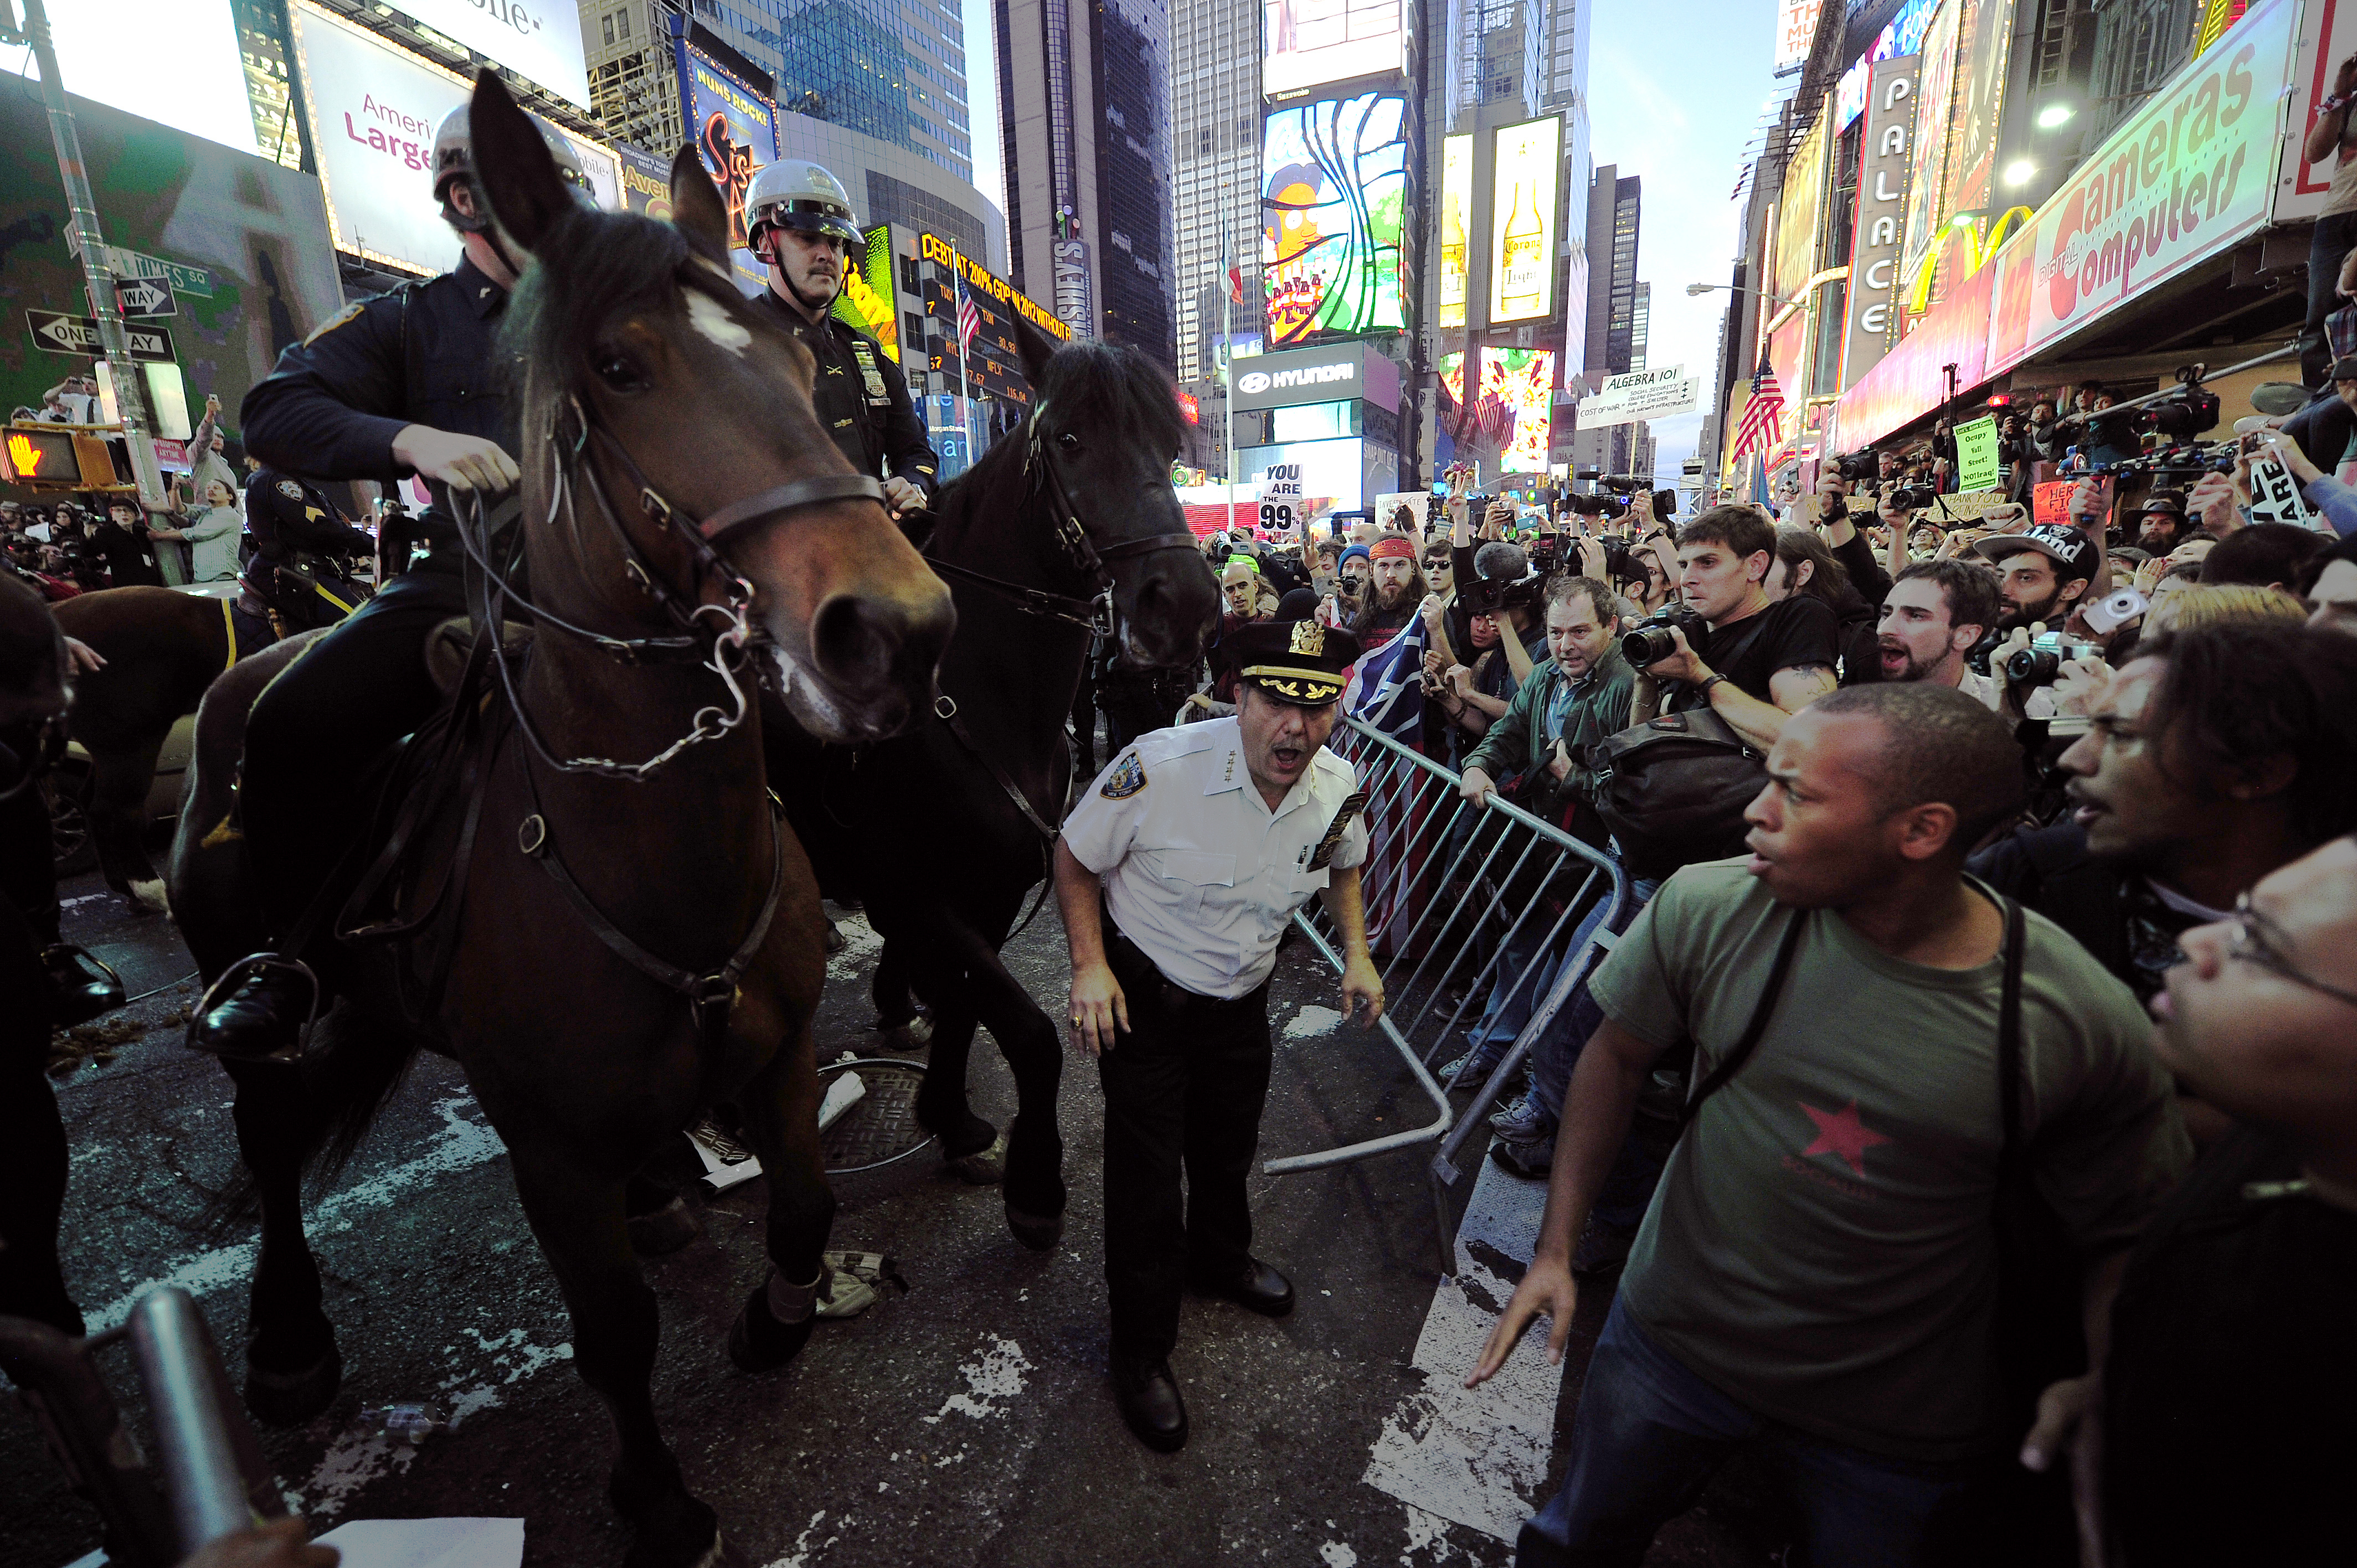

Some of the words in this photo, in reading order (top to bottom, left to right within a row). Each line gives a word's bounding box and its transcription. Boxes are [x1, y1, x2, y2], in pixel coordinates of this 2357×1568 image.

[2050, 43, 2256, 313] Cameras
[1861, 77, 1912, 333] PALACE
[1505, 239, 1541, 254] Corona
[135, 256, 185, 289] TIMES
[189, 270, 205, 285] SQ
[2037, 242, 2078, 288] DIGITAL
[124, 290, 156, 305] WAY
[922, 233, 953, 270] DEBT
[969, 260, 993, 295] 200%
[1012, 289, 1021, 312] IN
[1021, 295, 1036, 323] 2012
[1037, 306, 1067, 341] WITHOUT
[54, 324, 96, 345] ONE
[1273, 362, 1355, 389] HYUNDAI
[1606, 372, 1655, 391] ALGEBRA
[1659, 368, 1677, 382] 101
[1649, 383, 1679, 393] SECURITY
[1580, 407, 1597, 418] COST
[1598, 406, 1607, 414] OF
[1607, 403, 1620, 412] WAR
[929, 425, 949, 434] Morgan
[1267, 465, 1300, 481] YOU
[1272, 483, 1301, 494] ARE
[1941, 493, 1974, 504] THANK
[1977, 493, 2003, 504] YOU
[1260, 504, 1300, 530] 99%
